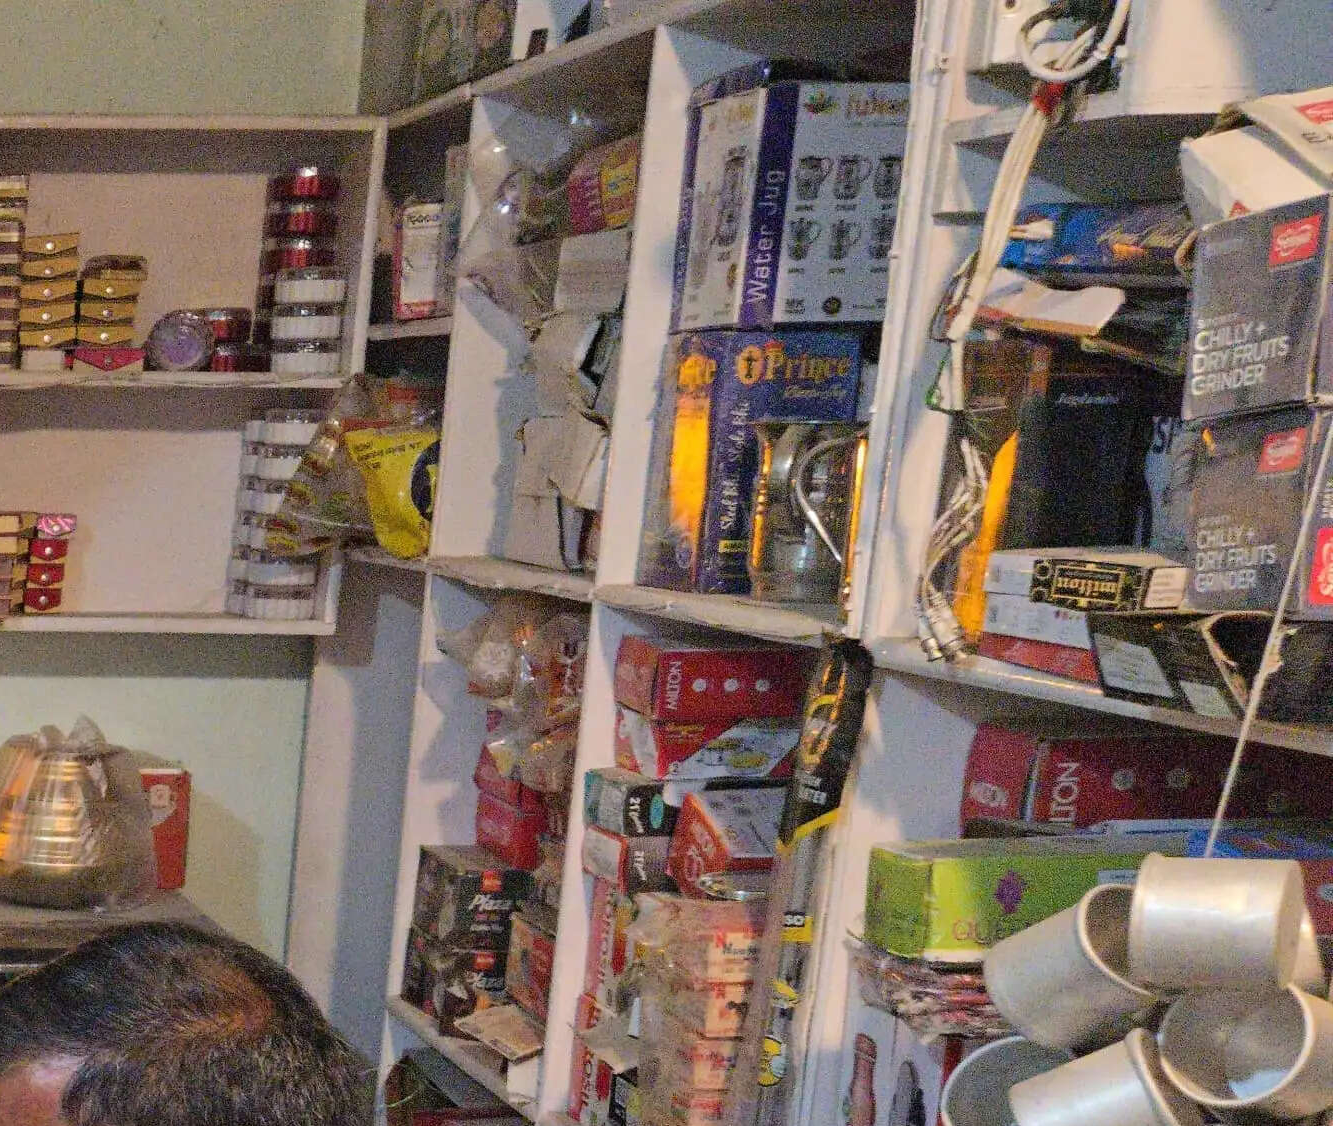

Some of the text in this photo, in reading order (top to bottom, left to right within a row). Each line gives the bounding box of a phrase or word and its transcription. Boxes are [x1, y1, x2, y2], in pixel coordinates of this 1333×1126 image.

[745, 169, 785, 304] Water Jug
[1190, 363, 1267, 396] GRINDER
[1191, 335, 1291, 375] DRY FRUITS
[665, 661, 683, 711] MILTON
[1047, 760, 1081, 827] LTON
